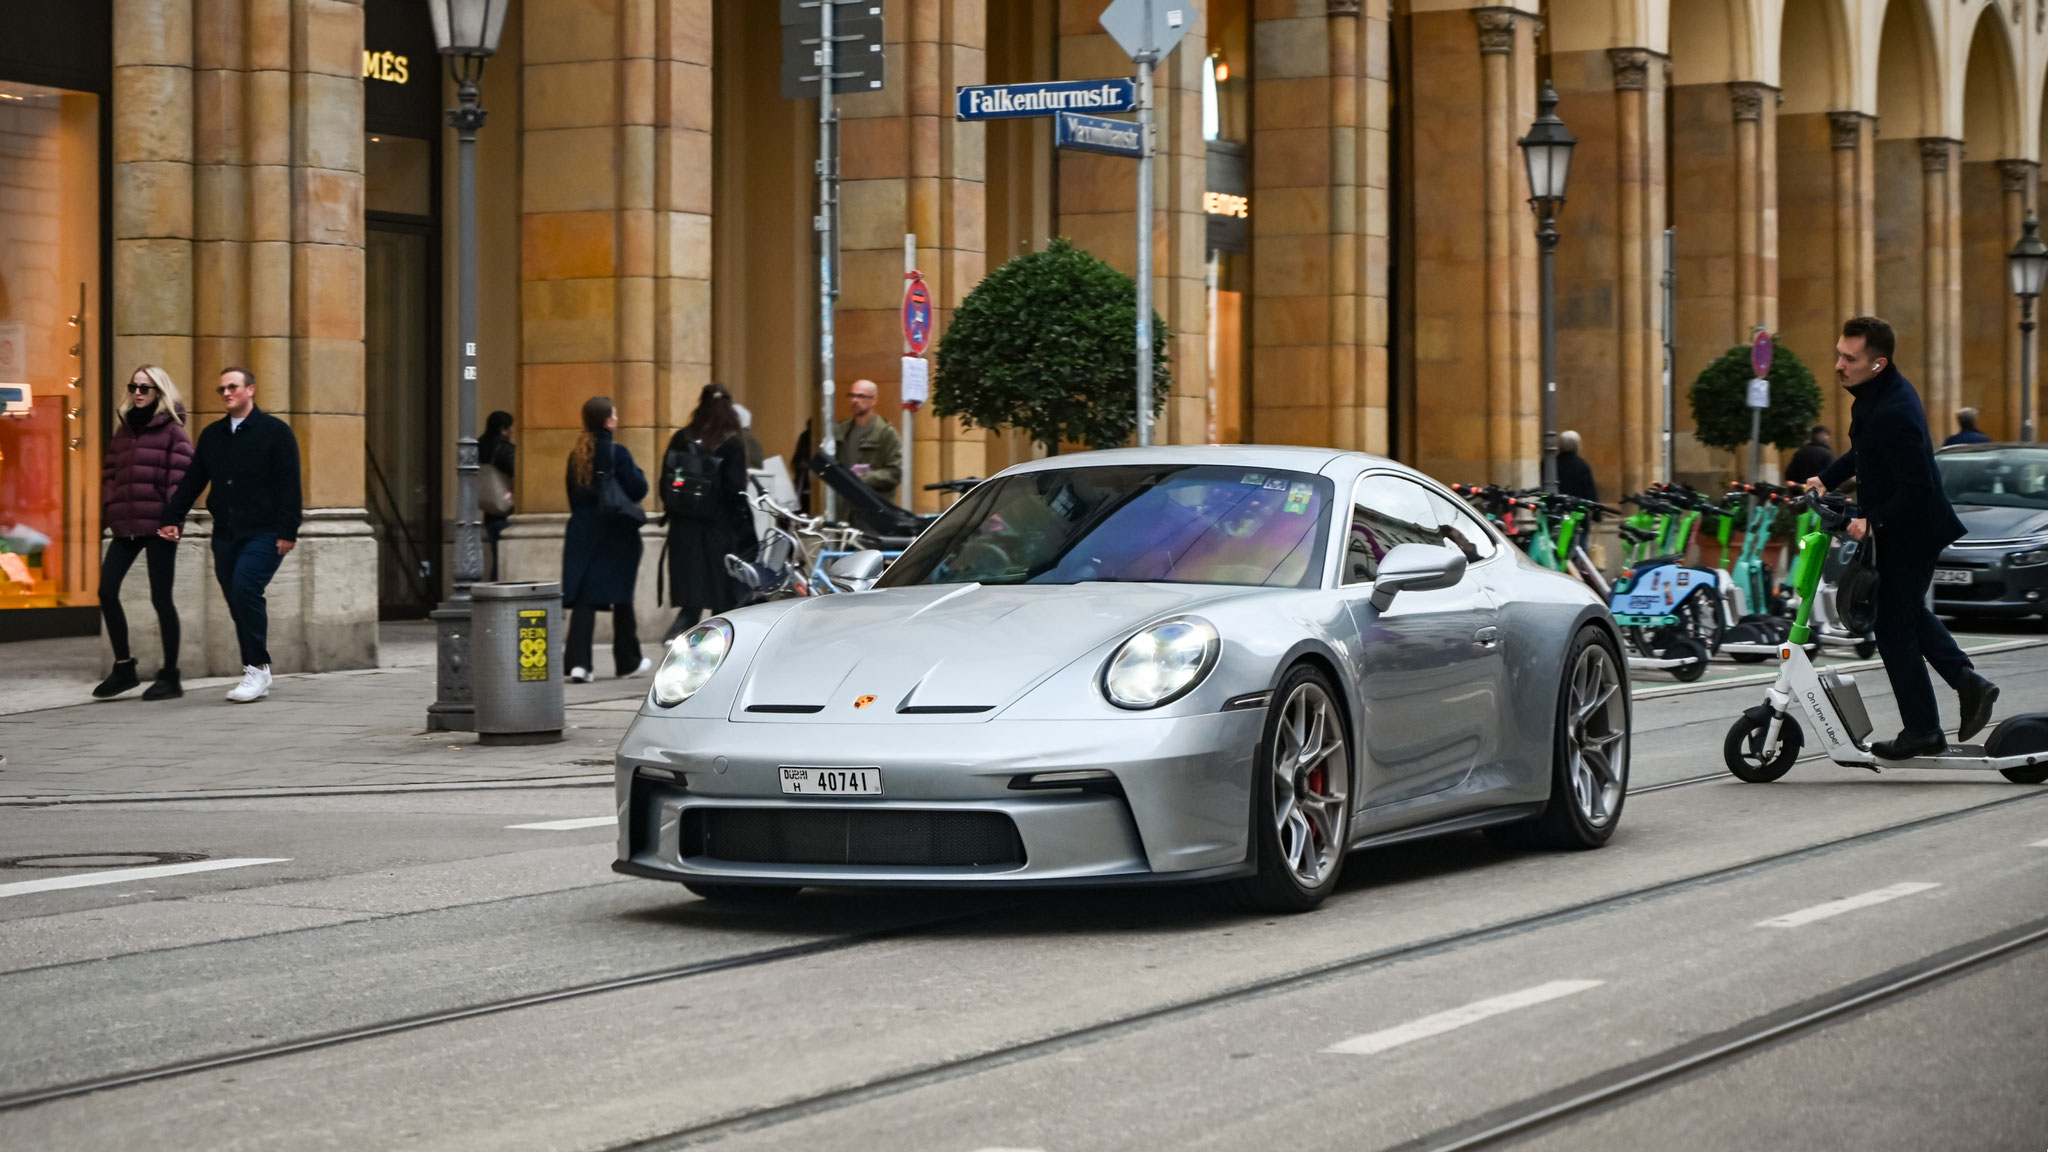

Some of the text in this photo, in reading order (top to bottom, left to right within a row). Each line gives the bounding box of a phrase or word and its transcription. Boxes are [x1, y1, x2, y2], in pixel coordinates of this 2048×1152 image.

[969, 84, 1123, 113] Falkenturmstr.
[520, 627, 546, 639] REIN
[1806, 691, 1816, 705] On
[1812, 703, 1826, 722] Lime
[1826, 726, 1840, 745] Uber
[793, 782, 801, 792] H
[817, 772, 867, 791] 40741
